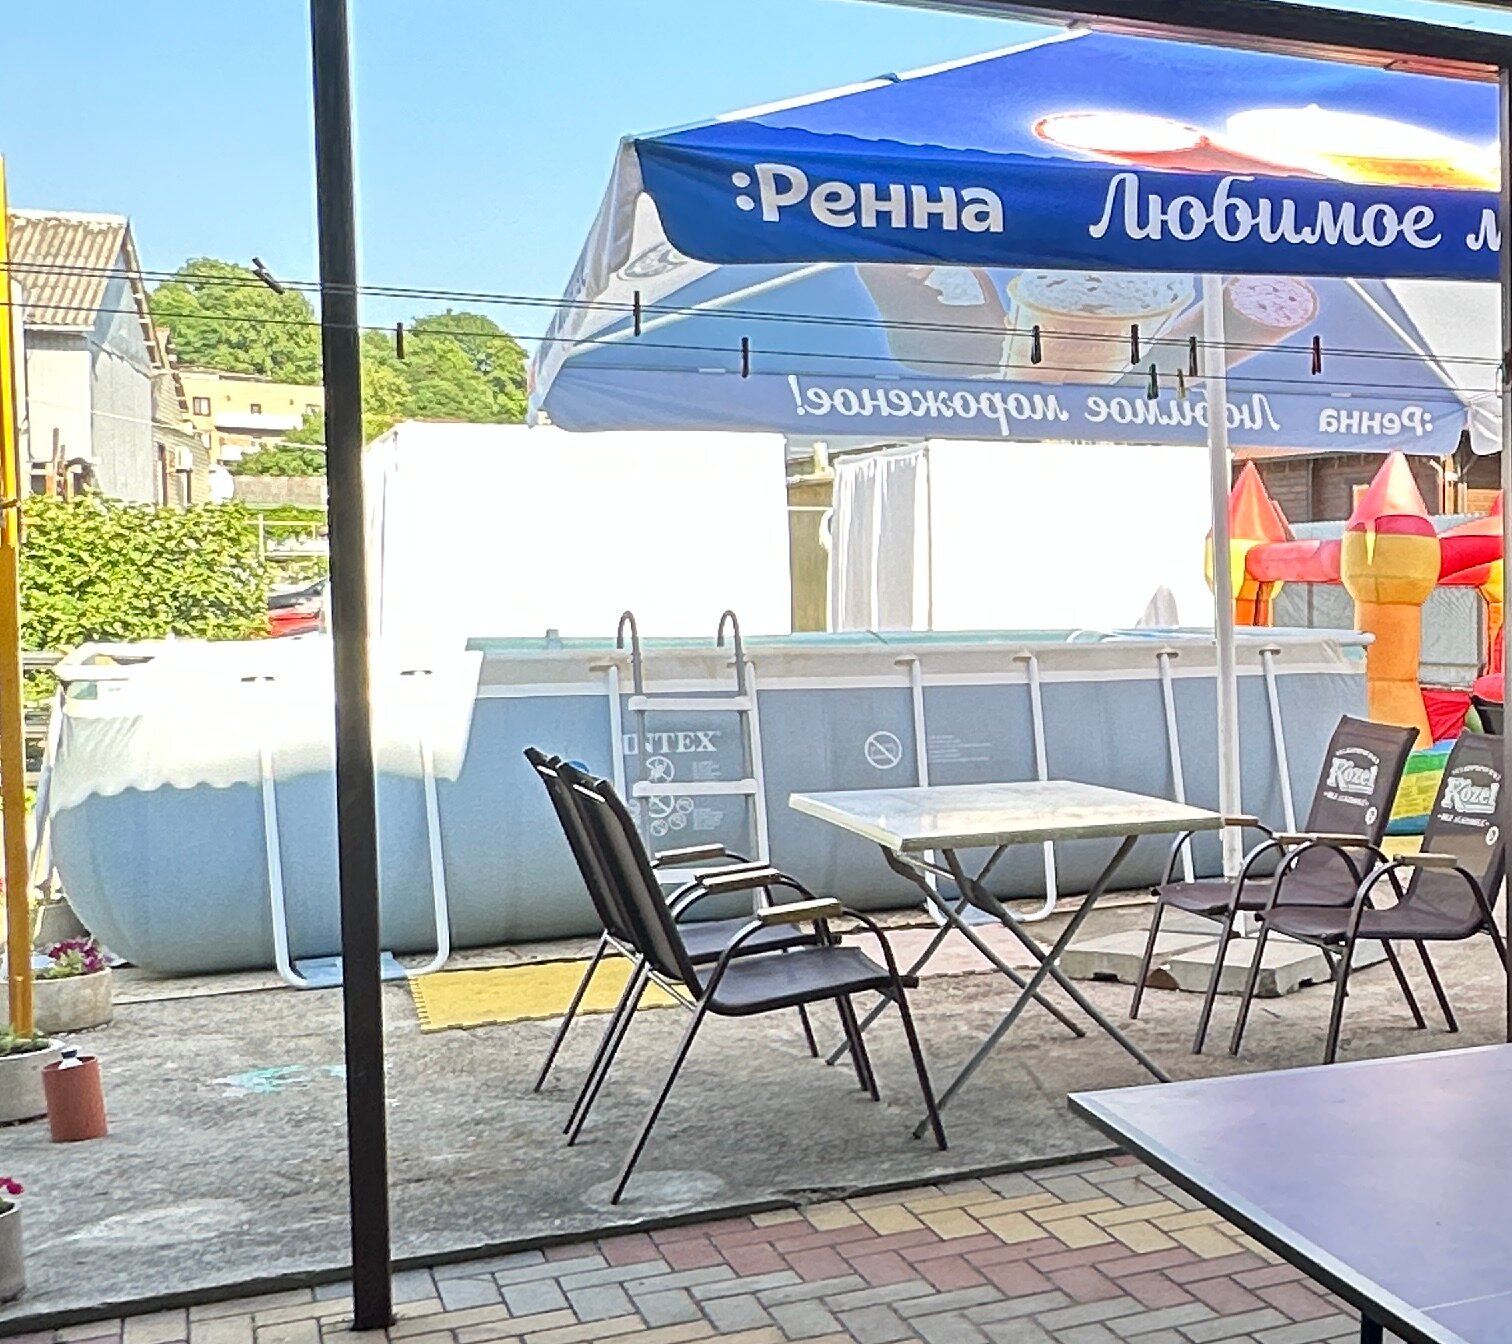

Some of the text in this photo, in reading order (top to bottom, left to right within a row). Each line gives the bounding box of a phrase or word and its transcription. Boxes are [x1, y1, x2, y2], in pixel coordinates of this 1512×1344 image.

[1088, 171, 1442, 250] Любимое
[1327, 757, 1379, 795] Kozel
[1441, 777, 1500, 814] Kozel
